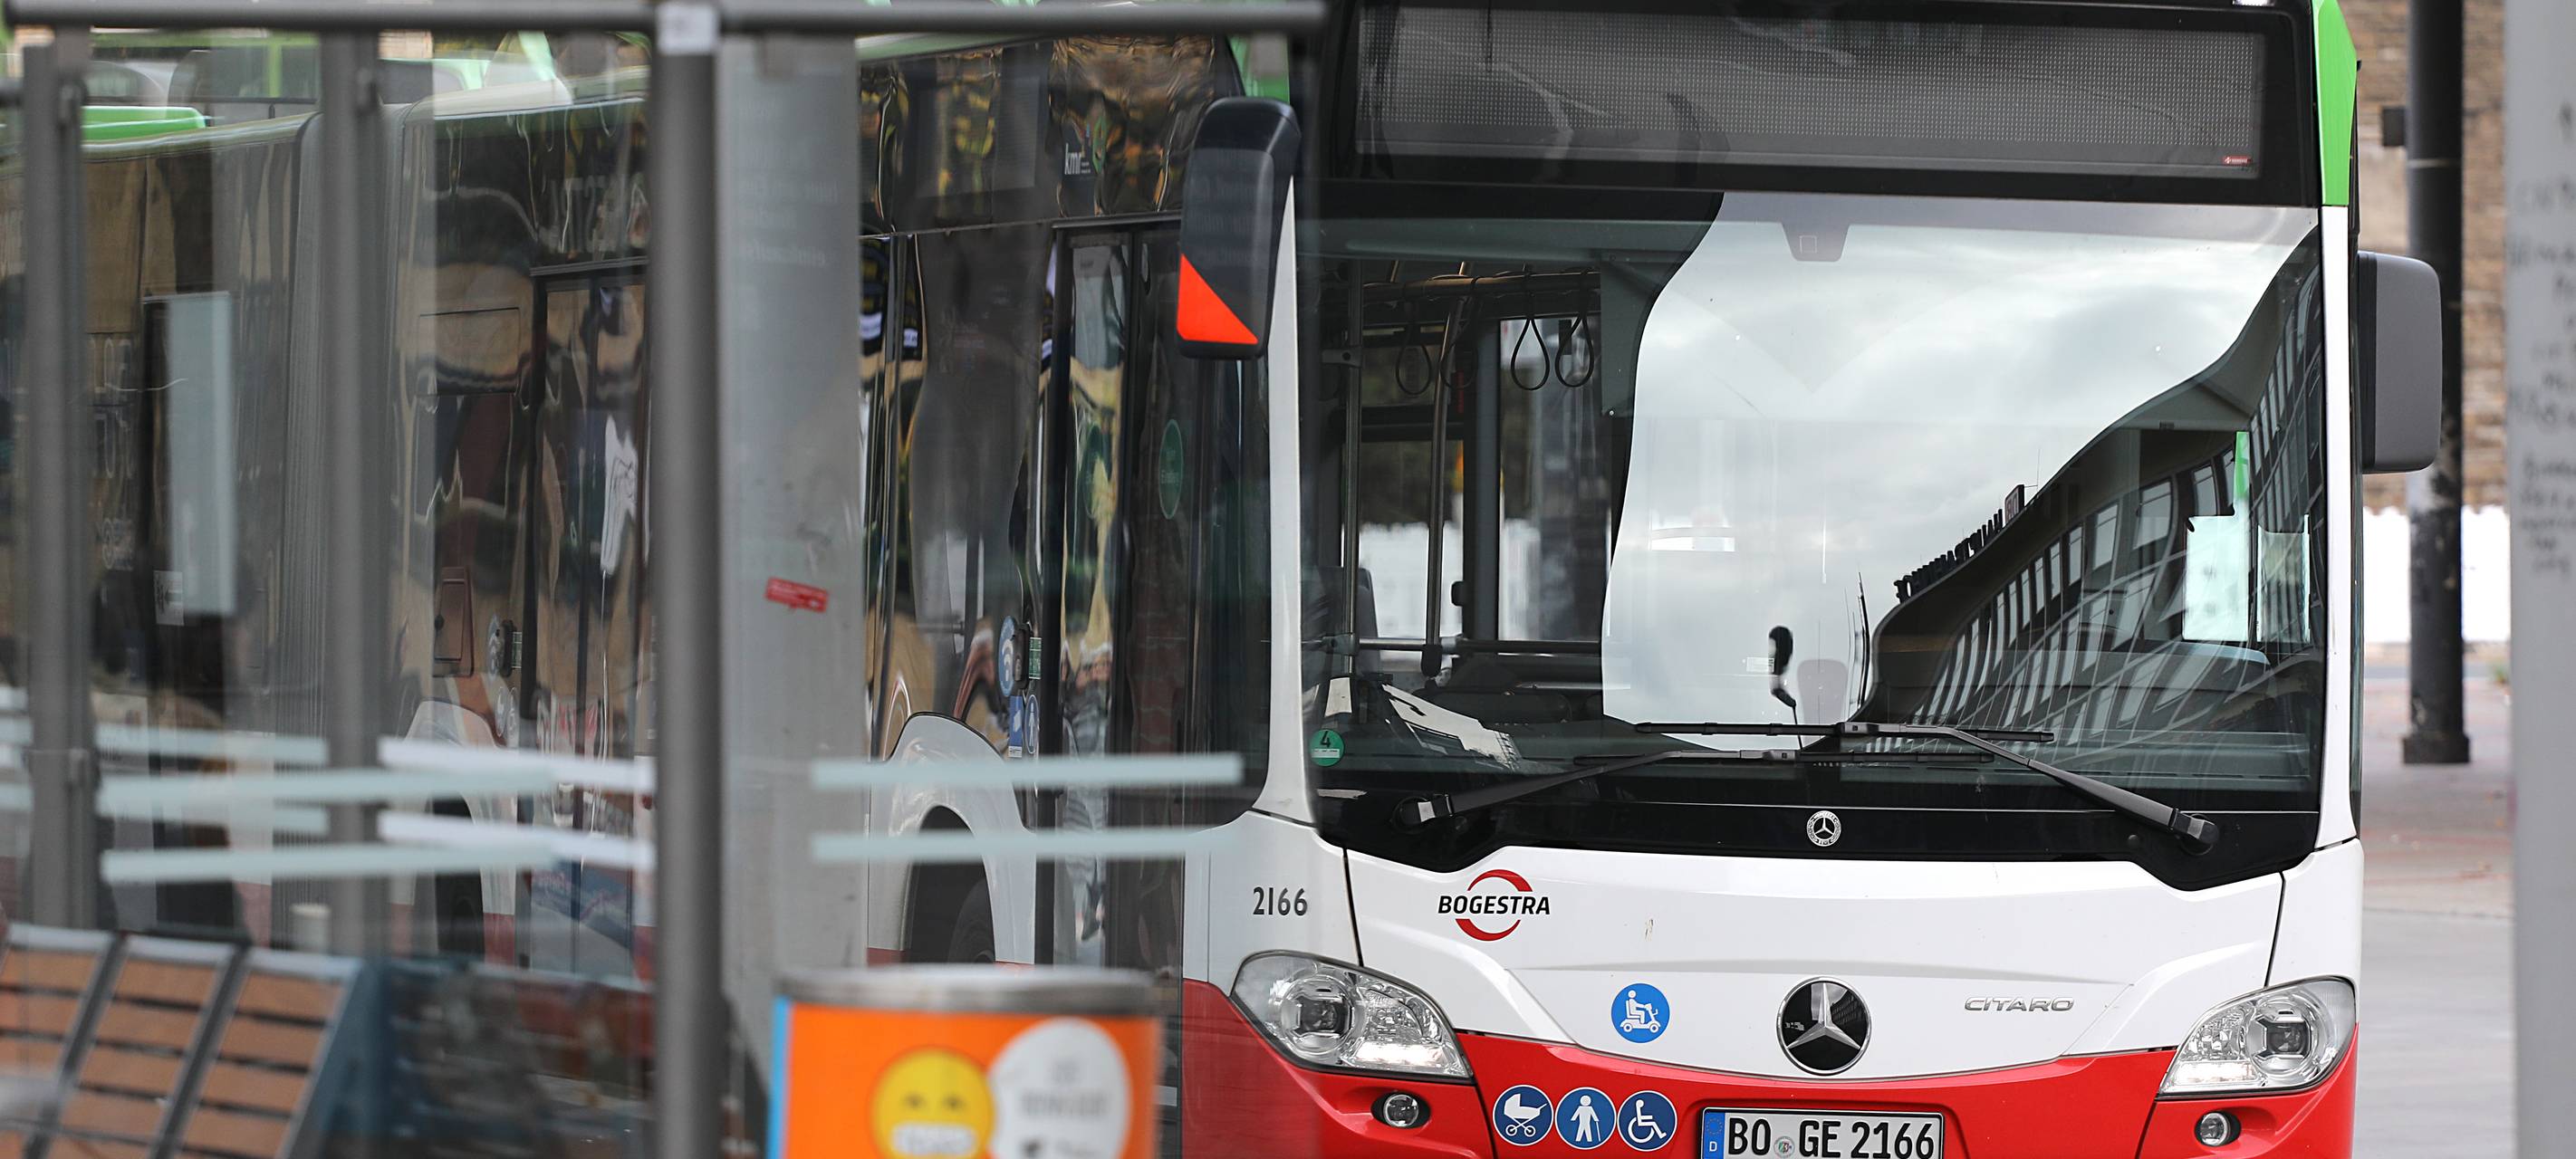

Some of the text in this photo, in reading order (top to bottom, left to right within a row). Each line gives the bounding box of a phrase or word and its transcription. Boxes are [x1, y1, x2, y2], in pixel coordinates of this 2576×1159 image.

[1320, 730, 1331, 749] 4
[1253, 886, 1308, 916] 2166
[1437, 895, 1551, 915] BOGESTRA
[1964, 996, 2075, 1012] CITARO
[1708, 1141, 1717, 1153] D
[1727, 1117, 1934, 1159] BO GE 2166
